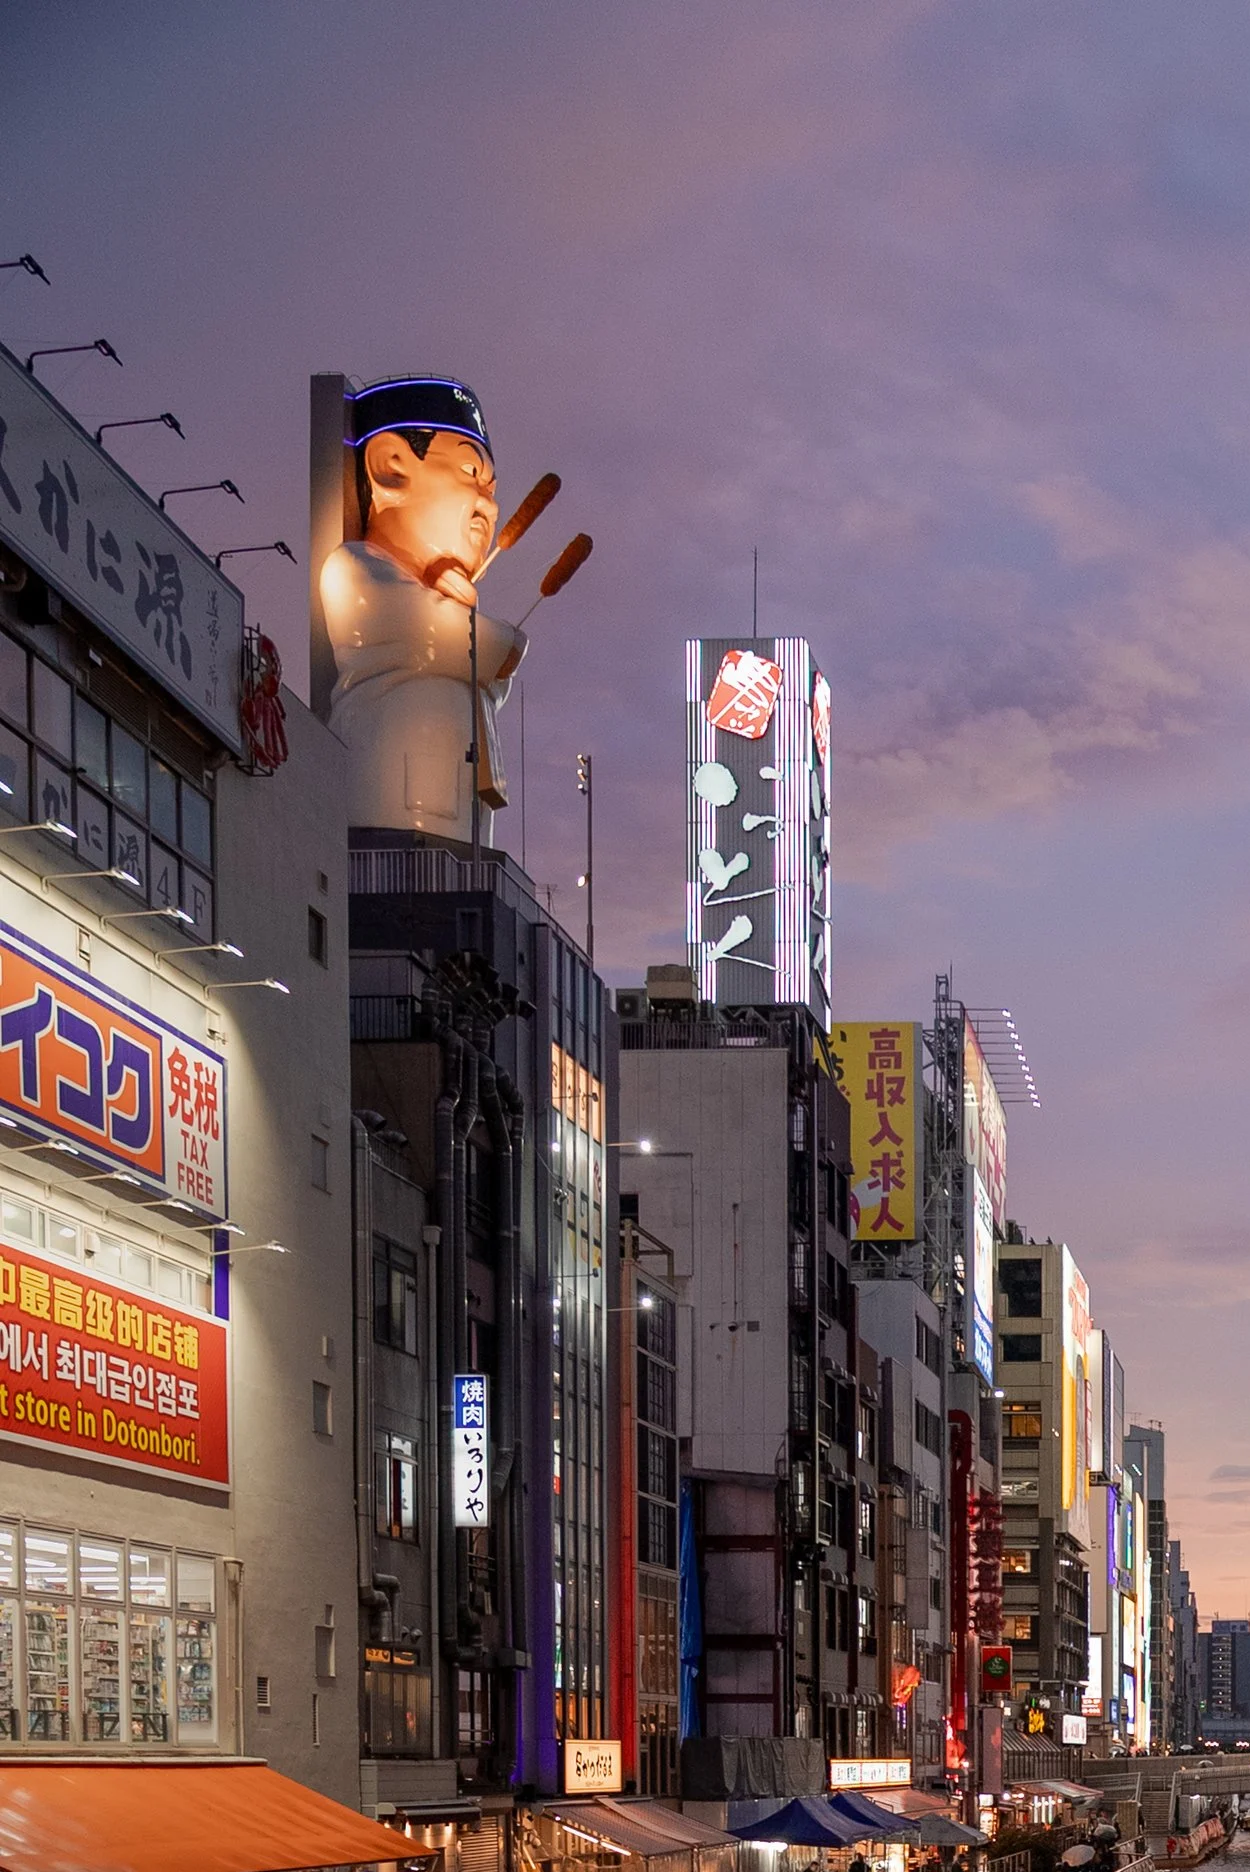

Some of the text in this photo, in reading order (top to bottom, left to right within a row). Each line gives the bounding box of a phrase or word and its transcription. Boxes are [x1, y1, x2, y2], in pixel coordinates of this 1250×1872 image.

[167, 1046, 219, 1141] 免税
[177, 1162, 214, 1206] FREE
[180, 1129, 209, 1170] TAX
[15, 1391, 71, 1433] store
[77, 1400, 97, 1439] in
[102, 1408, 201, 1466] Dotonbori.
[461, 1379, 485, 1522] 焼肉 いろりや
